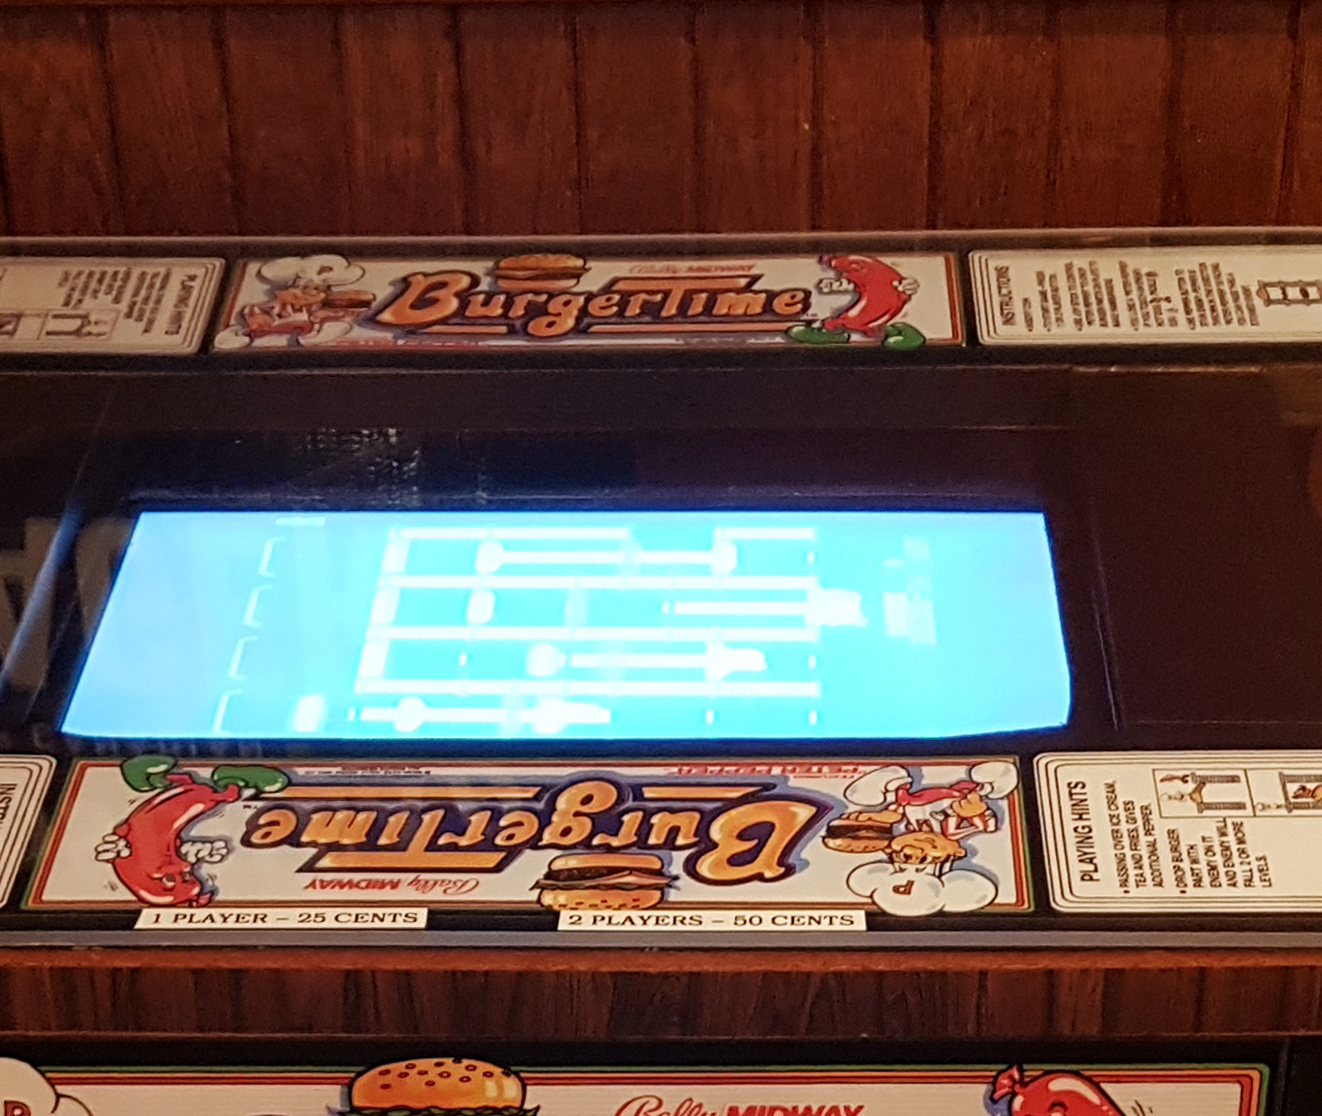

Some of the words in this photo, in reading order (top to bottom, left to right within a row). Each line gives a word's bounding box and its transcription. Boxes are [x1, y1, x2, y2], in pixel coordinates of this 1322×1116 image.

[376, 268, 813, 338] BurgerTime
[1065, 780, 1091, 821] HINTS
[1108, 813, 1122, 826] ICE
[1121, 800, 1137, 824] GIVES
[247, 779, 826, 884] BurgerTime
[1110, 828, 1125, 850] OVER
[1200, 834, 1213, 842] IT
[1230, 820, 1247, 844] MORE
[1072, 825, 1100, 882] PLAYING
[1165, 827, 1183, 862] BURGER
[1202, 844, 1216, 857] ON
[1218, 840, 1235, 867] ENEMY
[1236, 847, 1250, 858] OR
[1114, 852, 1131, 887] PASSING
[1130, 853, 1145, 870] AND
[1145, 838, 1165, 888] ADDITIONAL
[303, 877, 402, 890] MIDWAY
[1133, 872, 1148, 888] TEA
[1172, 864, 1188, 887] DROP
[1189, 866, 1205, 887] PART
[1205, 859, 1222, 887] ENEMY
[1223, 870, 1239, 887] AND
[1240, 868, 1256, 887] FALL
[407, 874, 481, 895] Bally
[892, 879, 914, 896] P
[151, 912, 161, 924] 1
[173, 912, 268, 924] PLAYER
[297, 912, 327, 924] 25
[334, 912, 419, 924] CENTS
[568, 915, 583, 926] 2
[591, 915, 704, 926] PLAYERS
[733, 915, 764, 926] 50
[771, 915, 856, 926] CENTS
